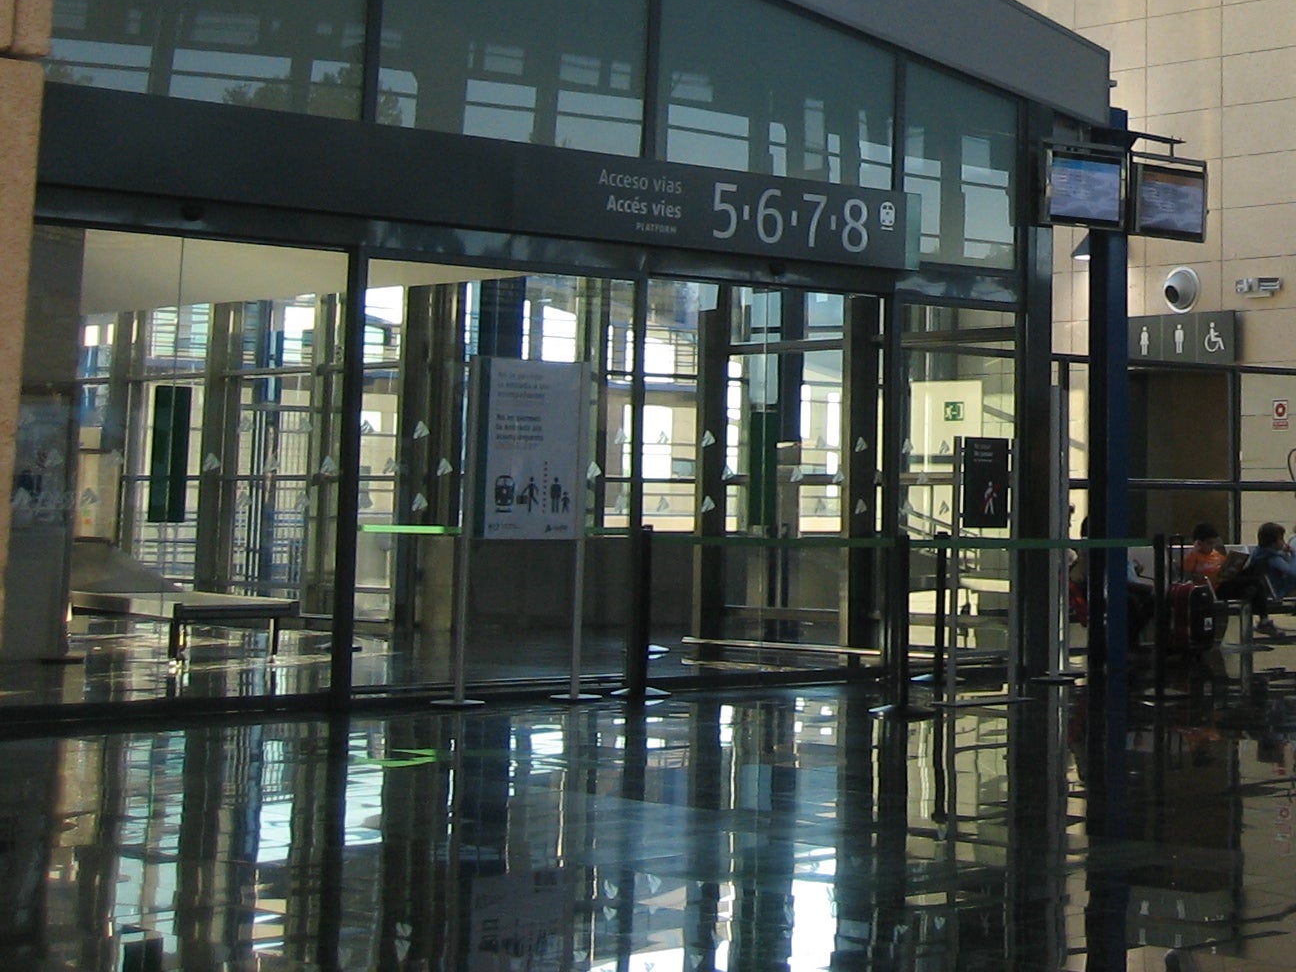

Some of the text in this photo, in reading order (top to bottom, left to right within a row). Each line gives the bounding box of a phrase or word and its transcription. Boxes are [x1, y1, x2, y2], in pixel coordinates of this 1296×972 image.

[599, 168, 650, 190] Acceso
[606, 194, 682, 219] Accés vies
